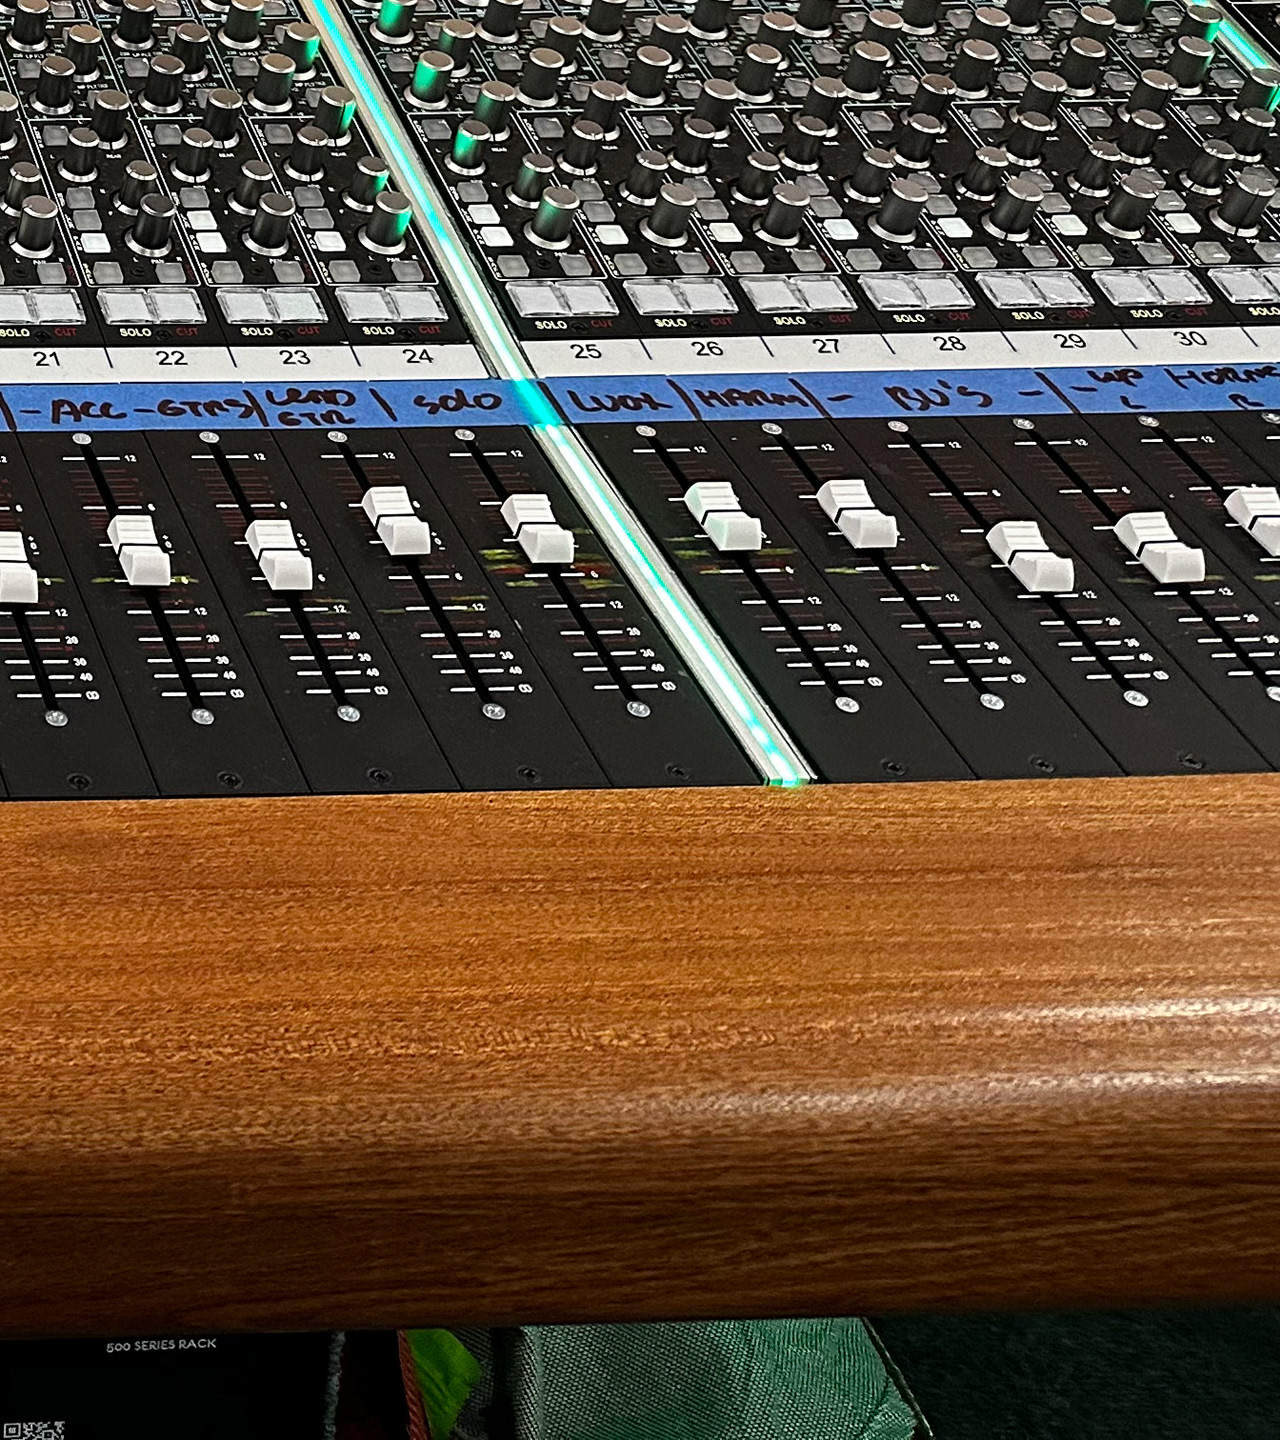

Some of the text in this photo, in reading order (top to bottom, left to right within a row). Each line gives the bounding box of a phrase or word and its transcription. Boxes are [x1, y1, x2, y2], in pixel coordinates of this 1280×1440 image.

[893, 314, 926, 324] SOLO
[120, 327, 152, 338] SOLO
[1173, 330, 1208, 347] 30
[690, 341, 724, 357] 26
[812, 338, 843, 354] 27
[932, 335, 967, 351] 28
[1053, 333, 1087, 349] 29
[32, 351, 61, 367] 21
[155, 350, 188, 366] 22
[279, 349, 311, 365] 23
[402, 348, 434, 364] 24
[569, 343, 602, 359] 25
[106, 1338, 217, 1353] 500 SERIES RACK
